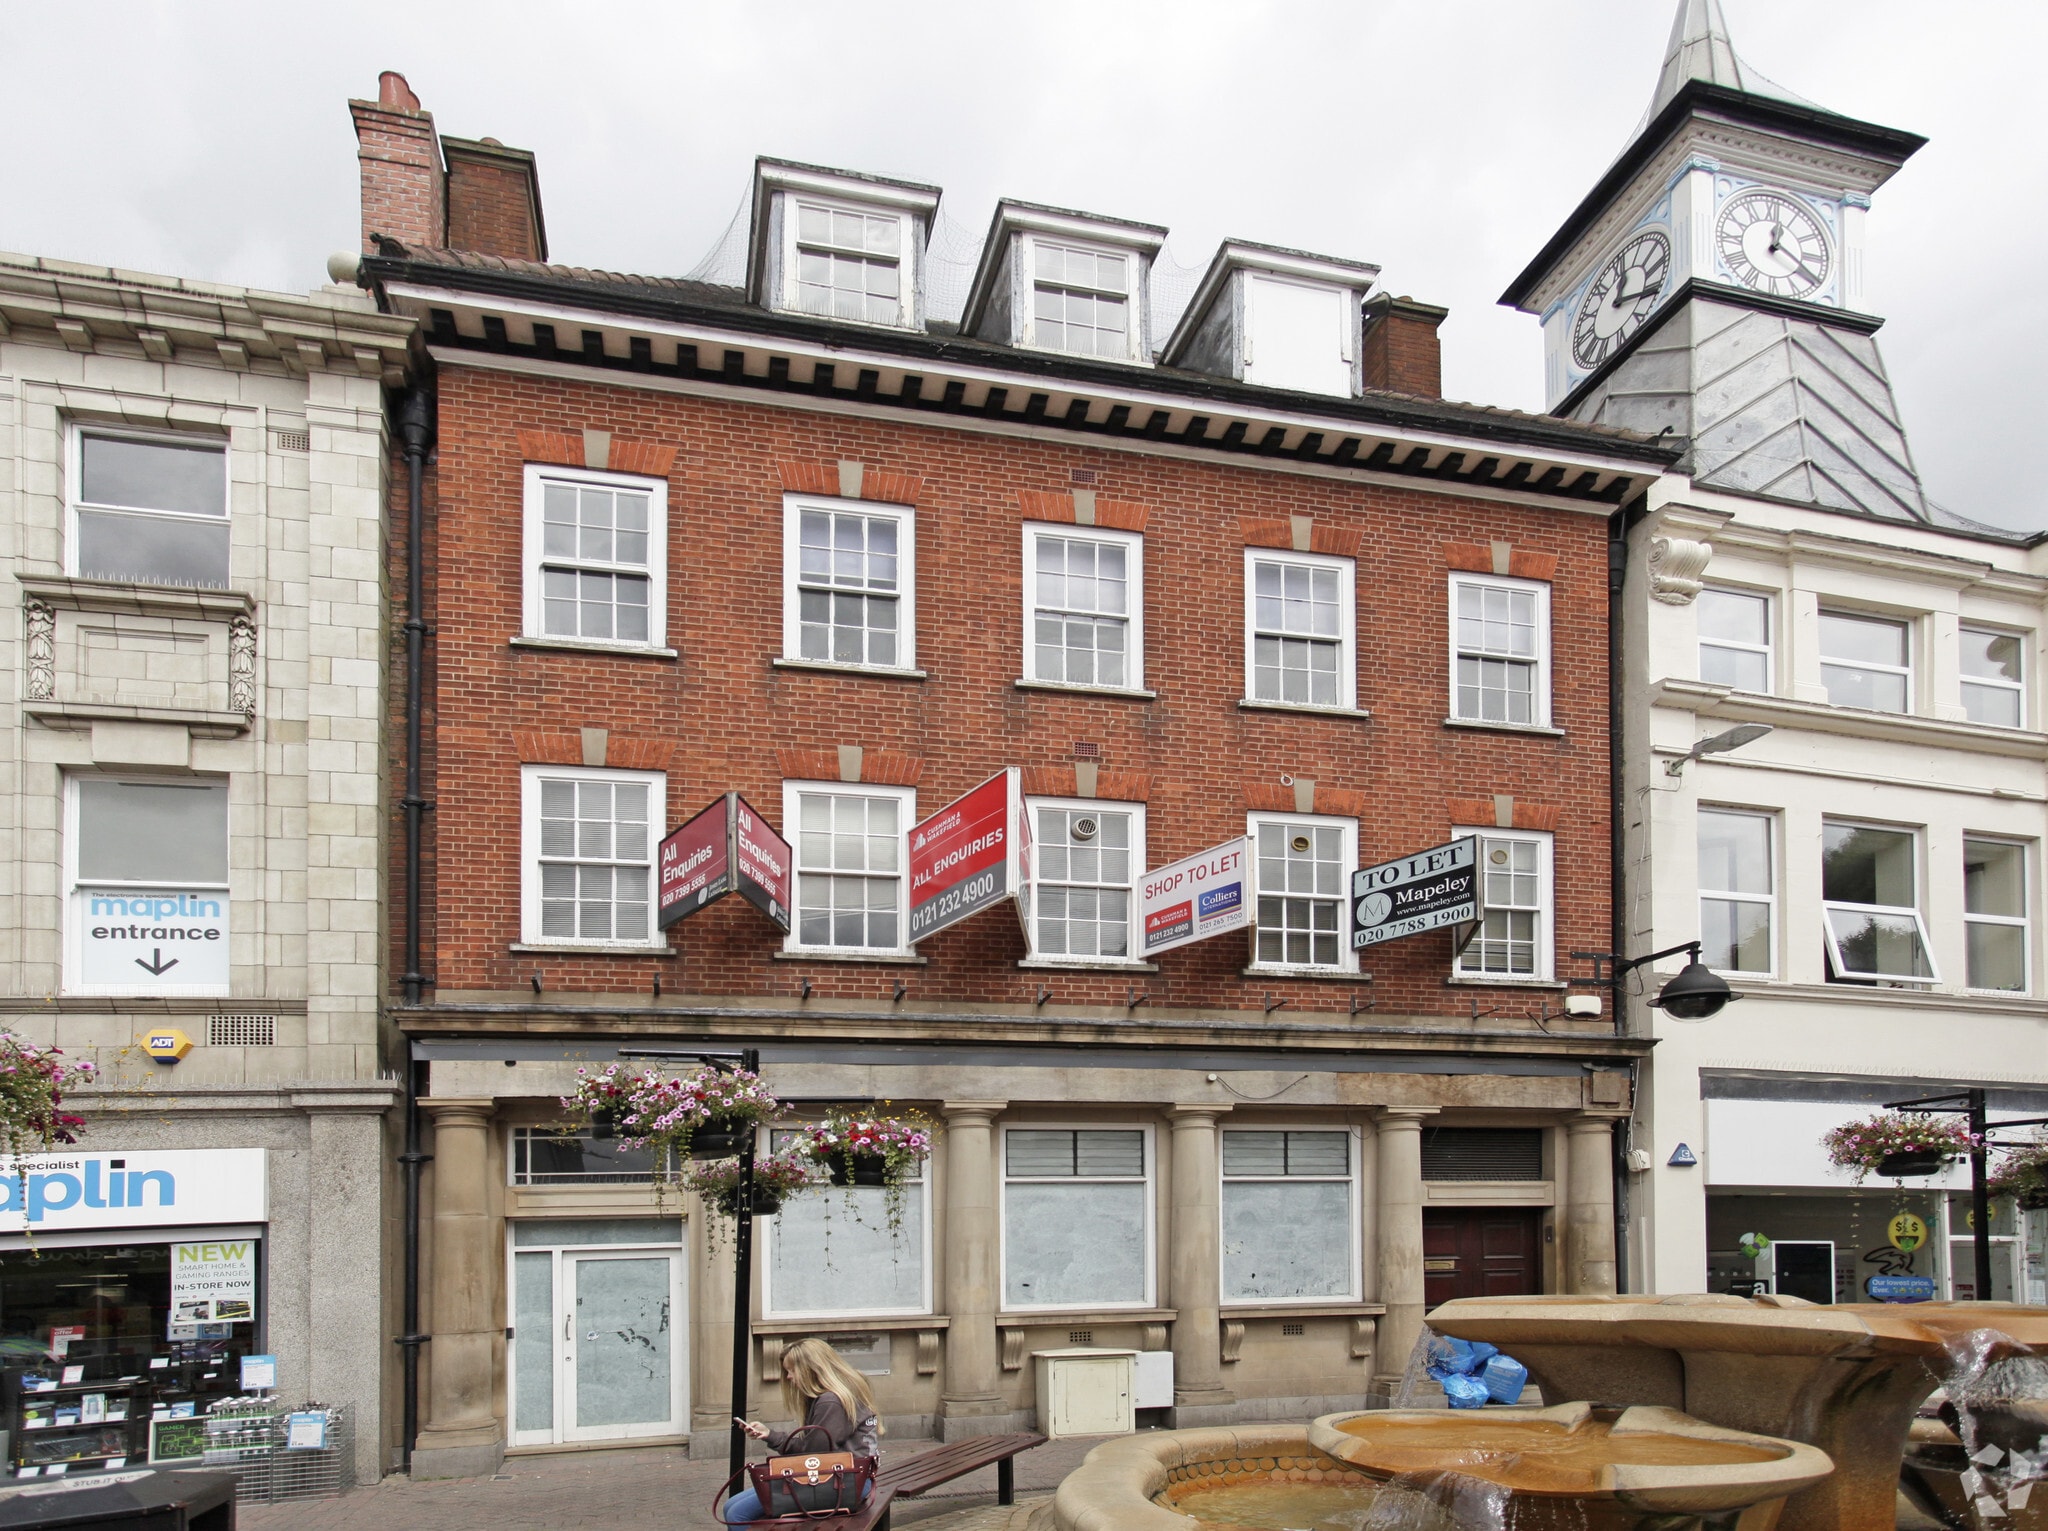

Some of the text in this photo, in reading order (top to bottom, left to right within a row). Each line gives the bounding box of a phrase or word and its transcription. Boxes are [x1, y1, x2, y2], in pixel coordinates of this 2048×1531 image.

[738, 809, 751, 832] All
[927, 814, 956, 836] CUSHMAN
[927, 818, 961, 842] WAKEFIELD
[662, 843, 677, 865] All
[738, 829, 781, 877] Enquiries
[913, 869, 932, 890] ALL
[934, 828, 1004, 876] ENQUIRIES
[663, 845, 713, 885] Enquiries
[739, 858, 750, 873] 020
[1145, 851, 1241, 900] SHOP TO LET
[1362, 846, 1463, 890] TO LET
[662, 892, 674, 906] 020
[912, 902, 937, 931] 0121
[939, 890, 961, 918] 232
[962, 873, 994, 904] 4900
[1202, 890, 1238, 906] Colliers
[1395, 876, 1470, 906] Mapeley
[91, 894, 220, 921] maplin
[1396, 892, 1471, 916] www.mapeley.com
[92, 924, 221, 940] entrance
[1149, 931, 1163, 942] 0121
[1163, 928, 1174, 938] 232
[1174, 922, 1189, 933] 4900
[1199, 912, 1243, 931] 0121 265 7500
[1358, 906, 1471, 944] 020 7788 1900
[151, 1038, 174, 1047] ADT
[9, 1160, 81, 1172] specialist
[0, 1159, 176, 1221] plin
[179, 1243, 248, 1263] NEW
[175, 1269, 250, 1280] GAMING RANGES
[178, 1263, 209, 1271] SMART
[211, 1262, 237, 1270] HOME
[174, 1280, 251, 1291] IN-STORE NOW
[73, 1479, 100, 1488] STUB
